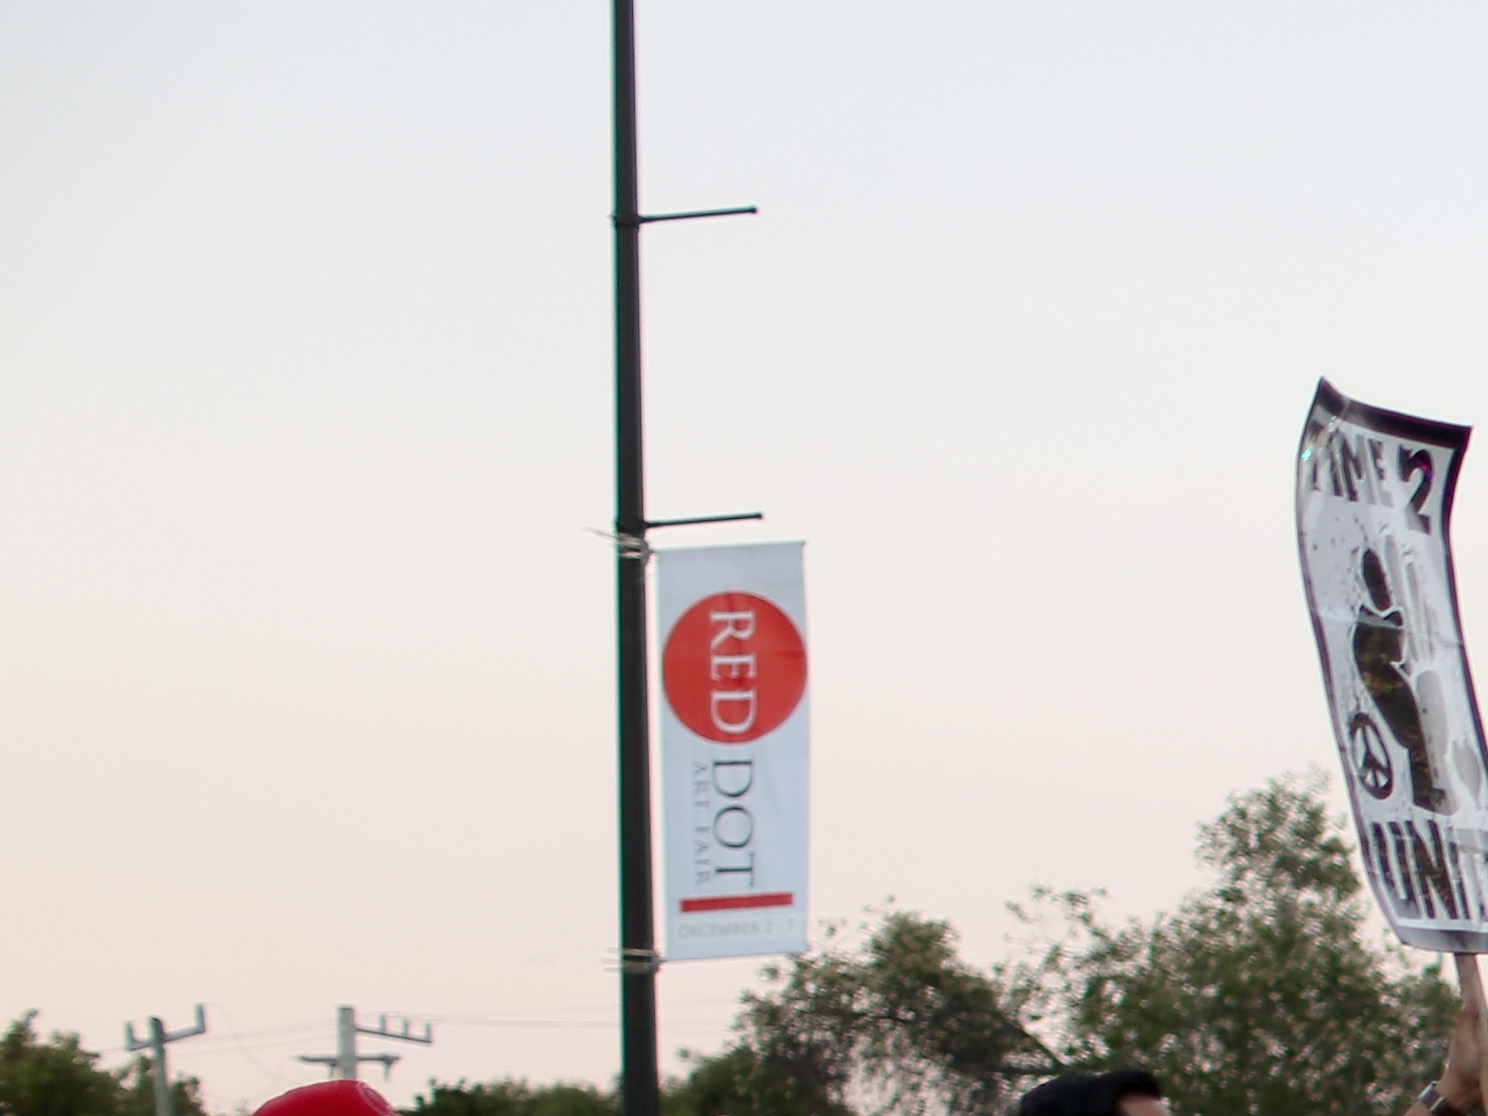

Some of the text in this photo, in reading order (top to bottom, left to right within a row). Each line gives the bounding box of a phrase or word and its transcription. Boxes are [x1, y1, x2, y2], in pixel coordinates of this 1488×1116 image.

[1306, 421, 1433, 535] TIME 2
[710, 609, 757, 734] RED
[711, 759, 754, 886] DOT
